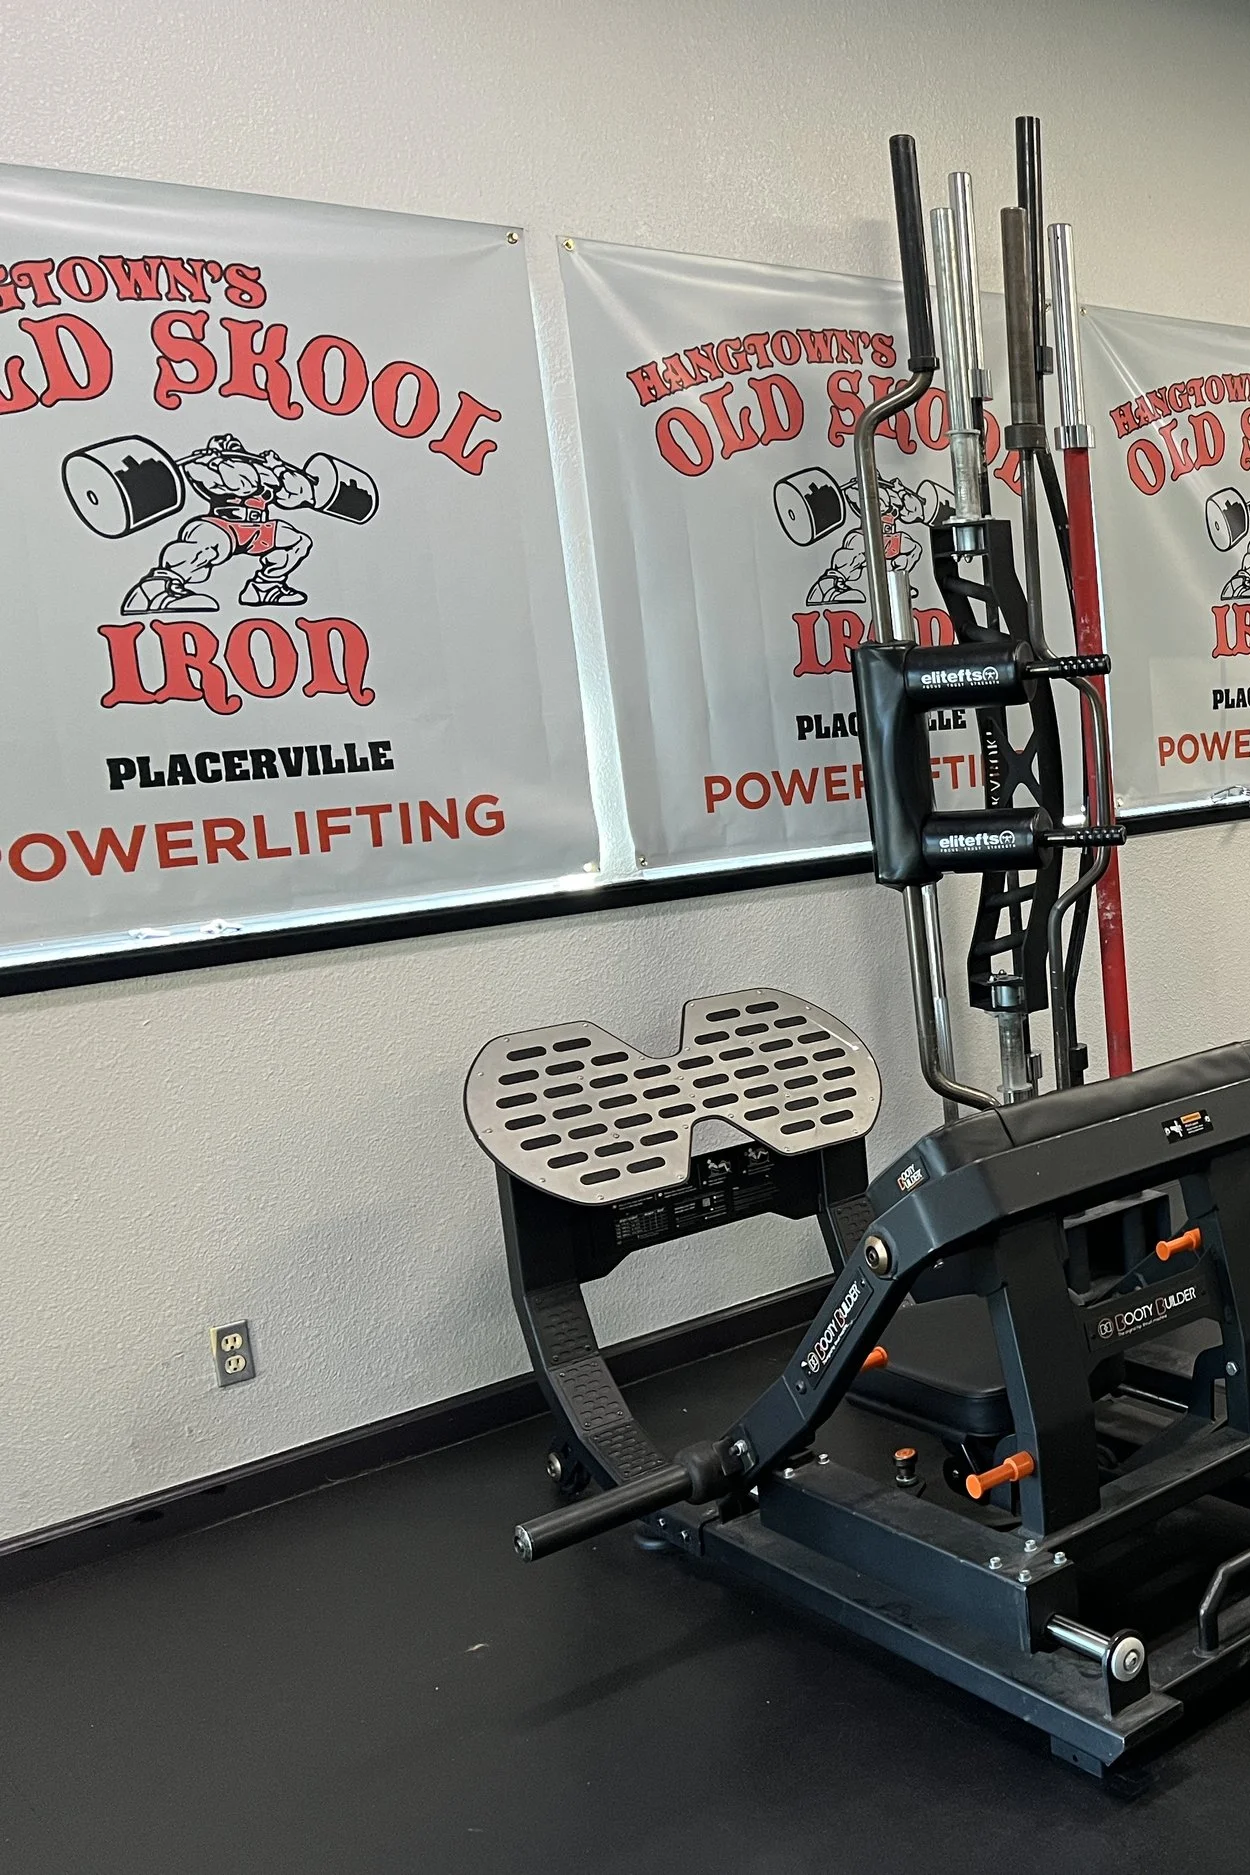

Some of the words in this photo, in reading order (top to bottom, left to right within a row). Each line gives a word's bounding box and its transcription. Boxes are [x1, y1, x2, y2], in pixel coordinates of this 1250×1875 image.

[150, 310, 502, 476] SKOOL
[626, 328, 897, 407] HANGTOWN'S
[655, 372, 804, 477] OLD
[1126, 410, 1226, 496] OLD
[97, 617, 375, 715] IRON
[920, 669, 983, 685] elitefts
[105, 740, 395, 790] PLACERVILLE
[0, 794, 505, 882] OWERLIFTING
[938, 832, 1000, 849] elitefts
[814, 1319, 839, 1361] BOOTY
[833, 1283, 861, 1328] BUILDER
[1114, 1303, 1154, 1333] BOOTY
[1155, 1286, 1197, 1316] BUILDER
